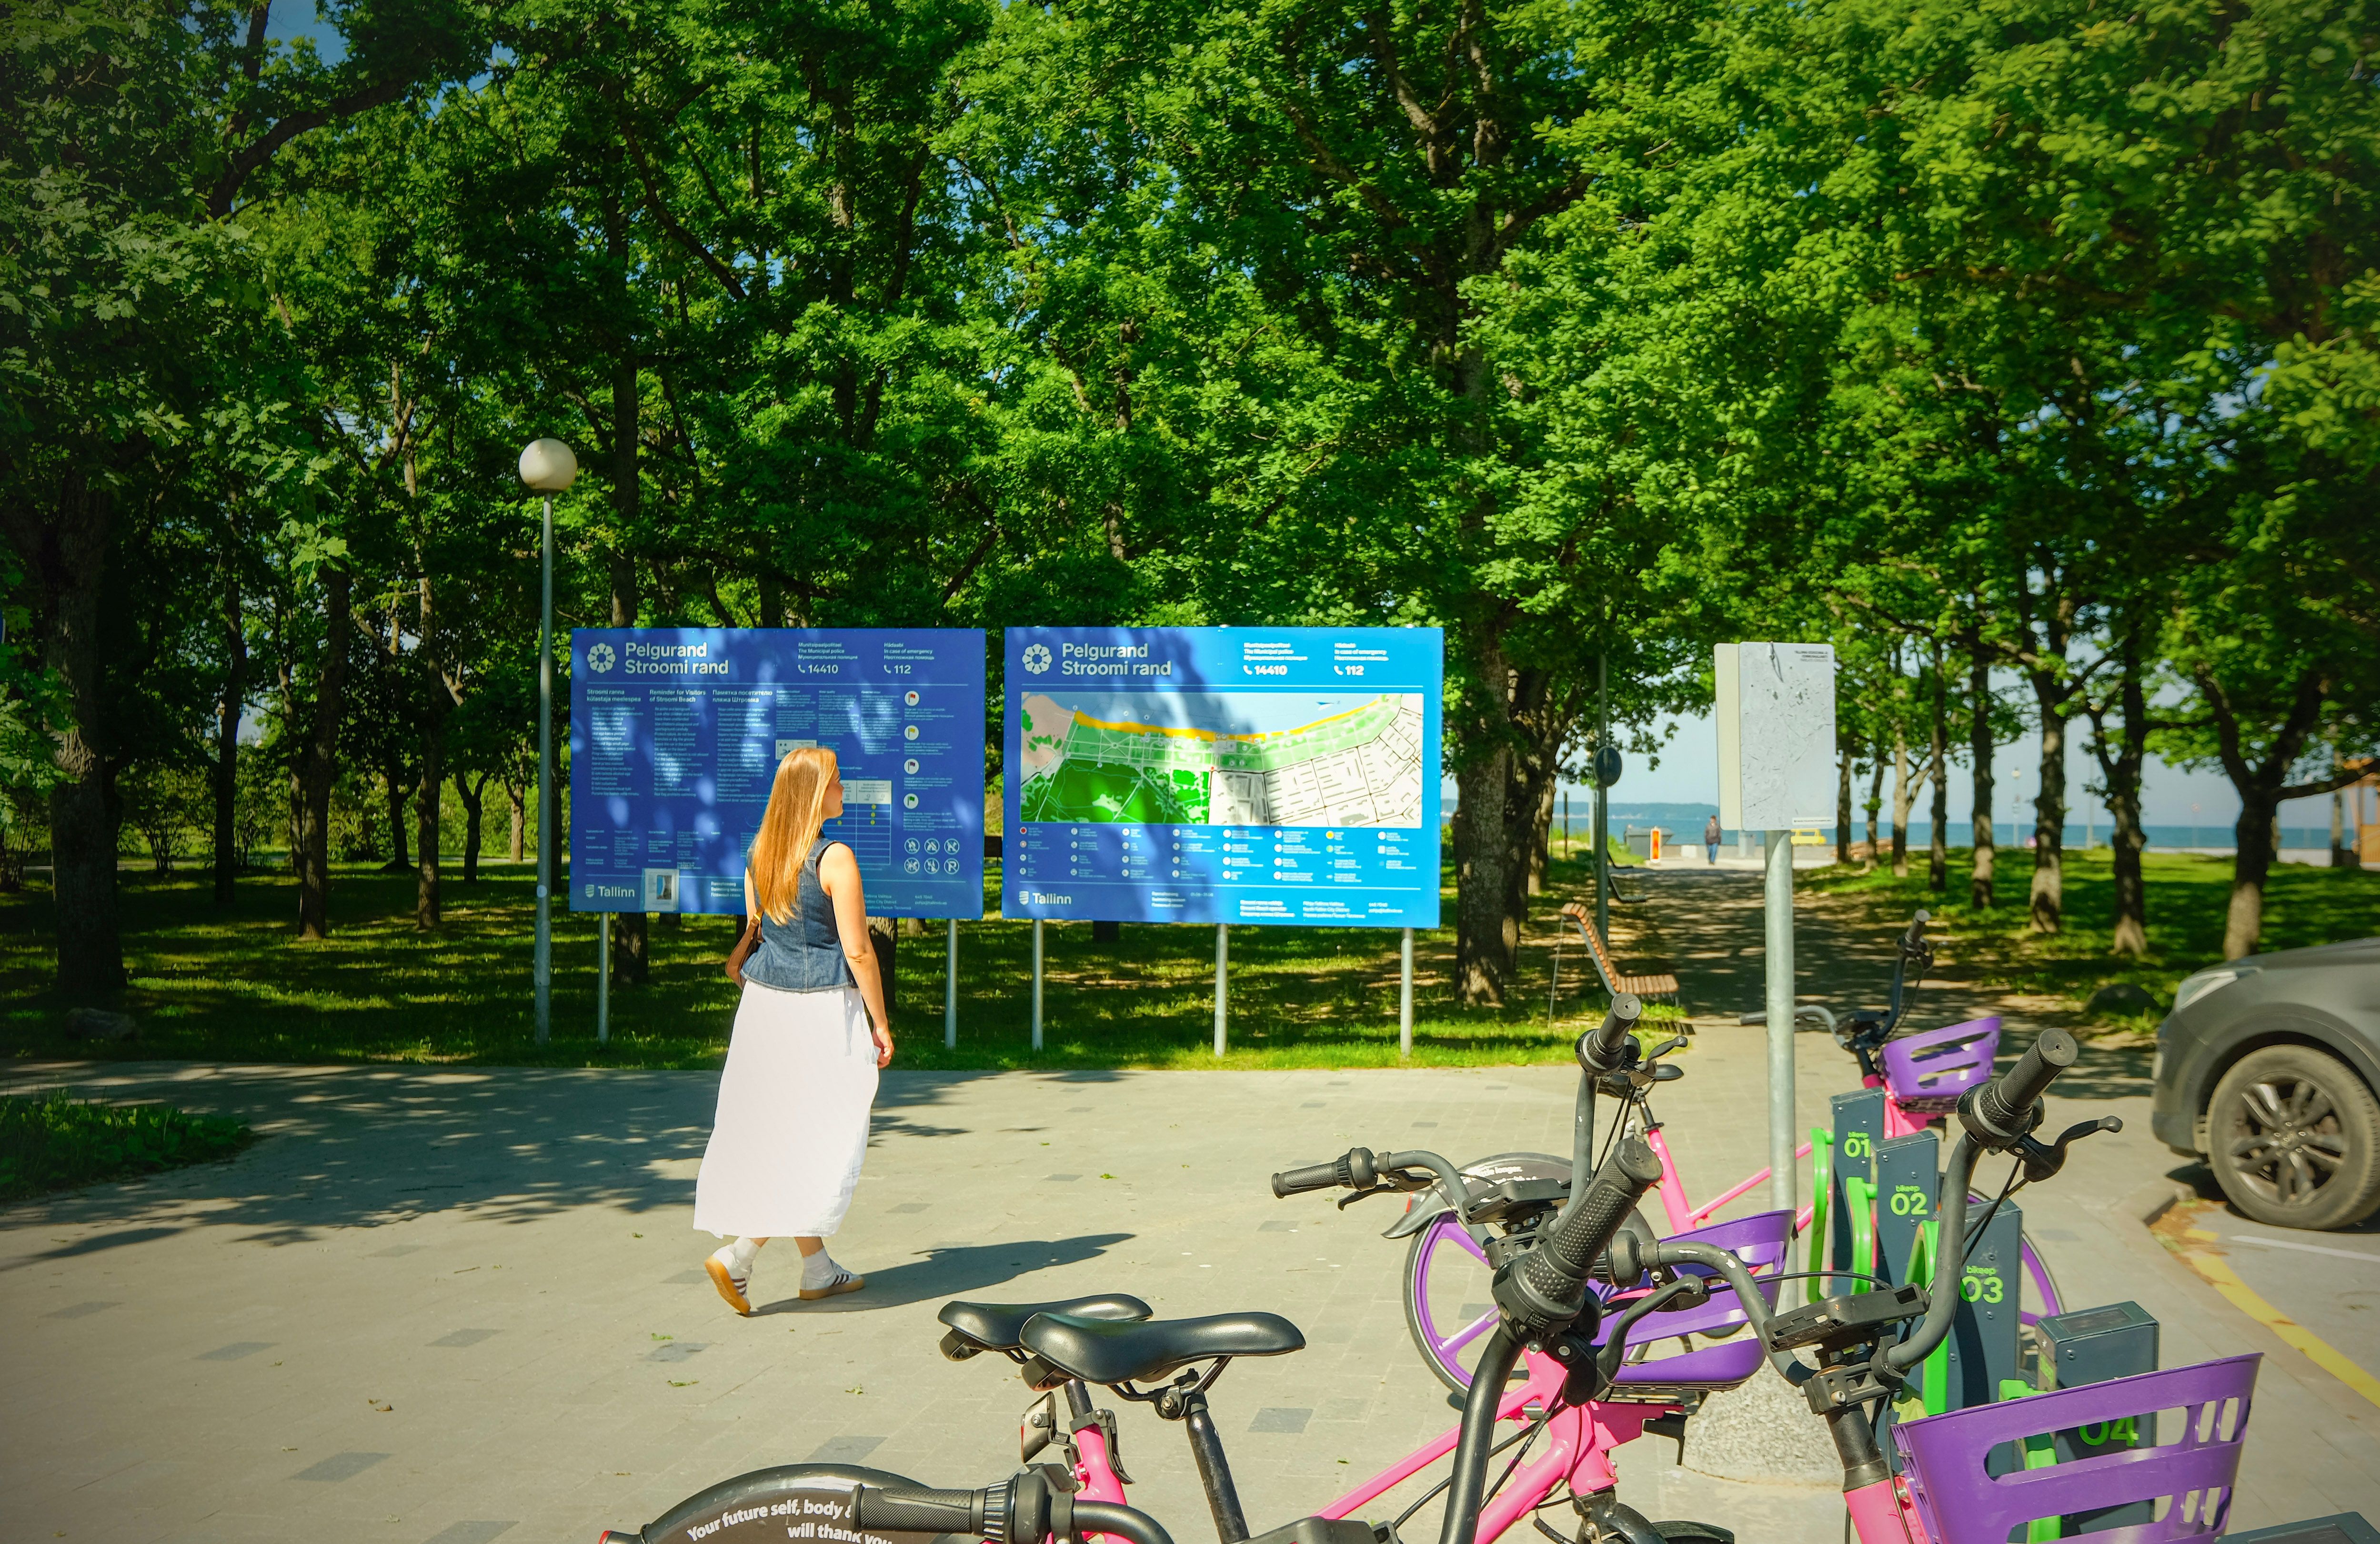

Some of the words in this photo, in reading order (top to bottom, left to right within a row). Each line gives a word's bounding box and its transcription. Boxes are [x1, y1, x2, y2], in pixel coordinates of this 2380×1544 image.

[625, 642, 707, 660] Pelgurand
[1062, 643, 1148, 661] Pelgurand
[625, 659, 688, 674] Stroomi
[693, 660, 729, 674] rand
[808, 664, 838, 674] 14410
[894, 665, 911, 674] 112
[1061, 660, 1128, 675] Stroomi
[1133, 661, 1172, 675] rand
[1254, 665, 1288, 675] 14410
[1345, 665, 1365, 675] 112
[598, 886, 635, 897] Tallinn
[1032, 892, 1071, 904] Tallinn
[1844, 1138, 1871, 1158] 01
[1890, 1192, 1928, 1216] 02
[1966, 1265, 1997, 1276] bikeep
[1959, 1275, 2004, 1303] 03
[2078, 1415, 2138, 1447] 04
[686, 1519, 721, 1542] Your
[721, 1504, 768, 1527] future
[770, 1499, 801, 1516] self,
[803, 1499, 843, 1520] body
[787, 1523, 814, 1538] will
[817, 1524, 862, 1544] thank
